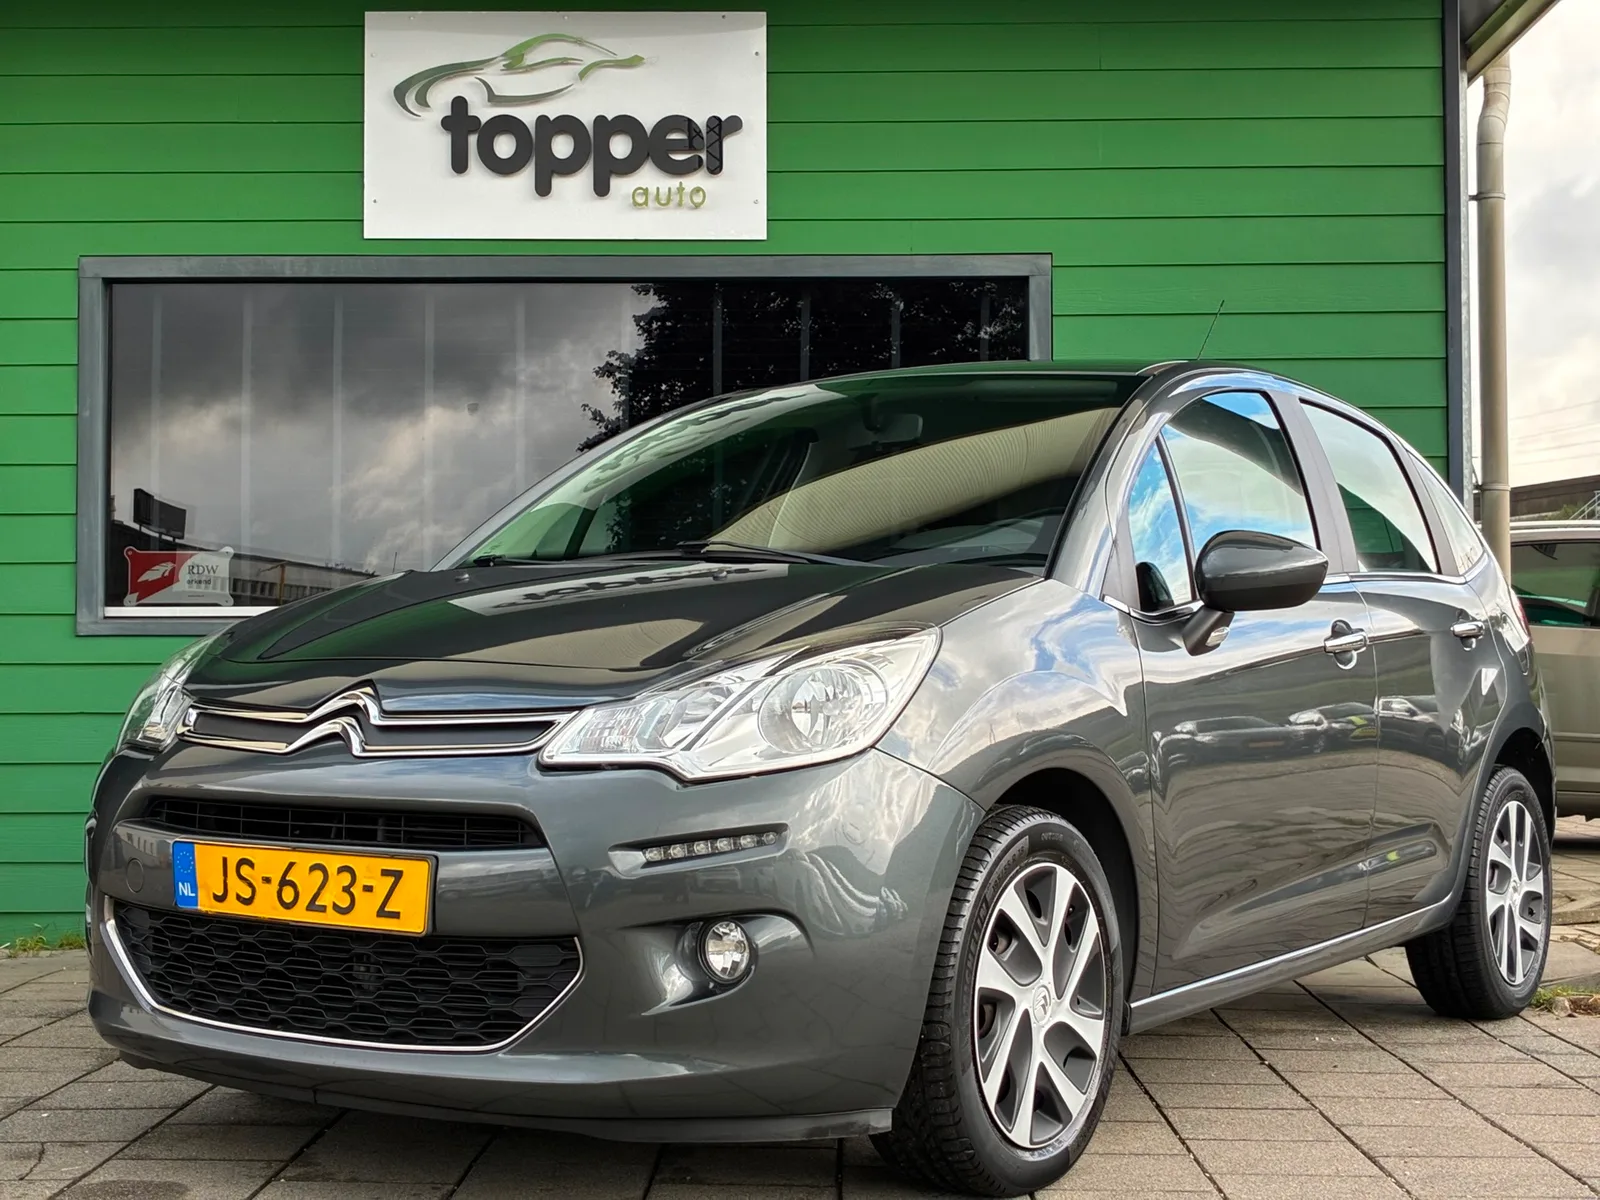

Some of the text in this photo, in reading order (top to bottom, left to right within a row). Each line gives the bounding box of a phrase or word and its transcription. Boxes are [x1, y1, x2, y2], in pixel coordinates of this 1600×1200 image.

[441, 95, 743, 197] topper
[631, 181, 706, 209] auto
[188, 565, 219, 575] RDW
[178, 881, 195, 897] NL
[212, 856, 404, 920] JS-623-Z
